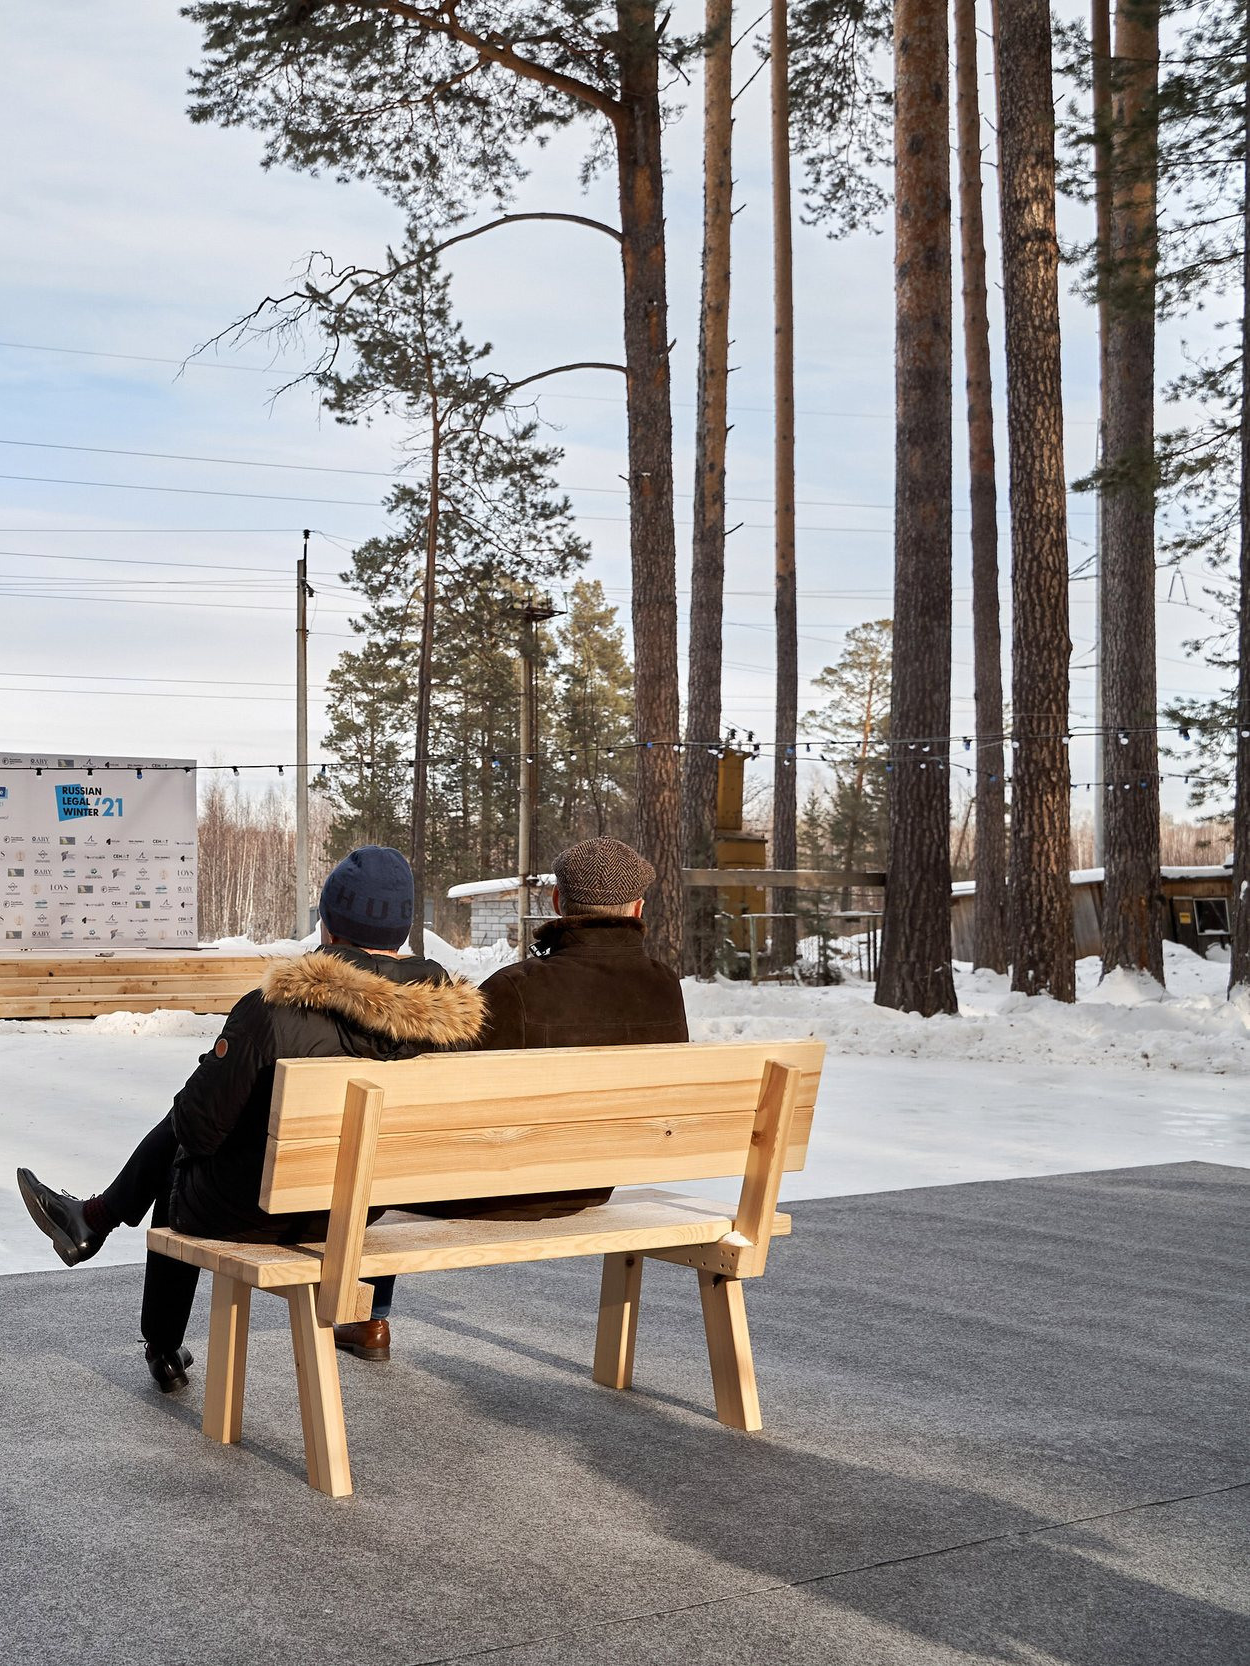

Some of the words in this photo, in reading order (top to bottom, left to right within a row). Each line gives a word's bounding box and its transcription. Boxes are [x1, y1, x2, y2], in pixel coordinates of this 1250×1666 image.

[62, 786, 102, 796] RUSSIAN
[62, 797, 91, 806] LEGAL
[63, 807, 99, 817] WINTER
